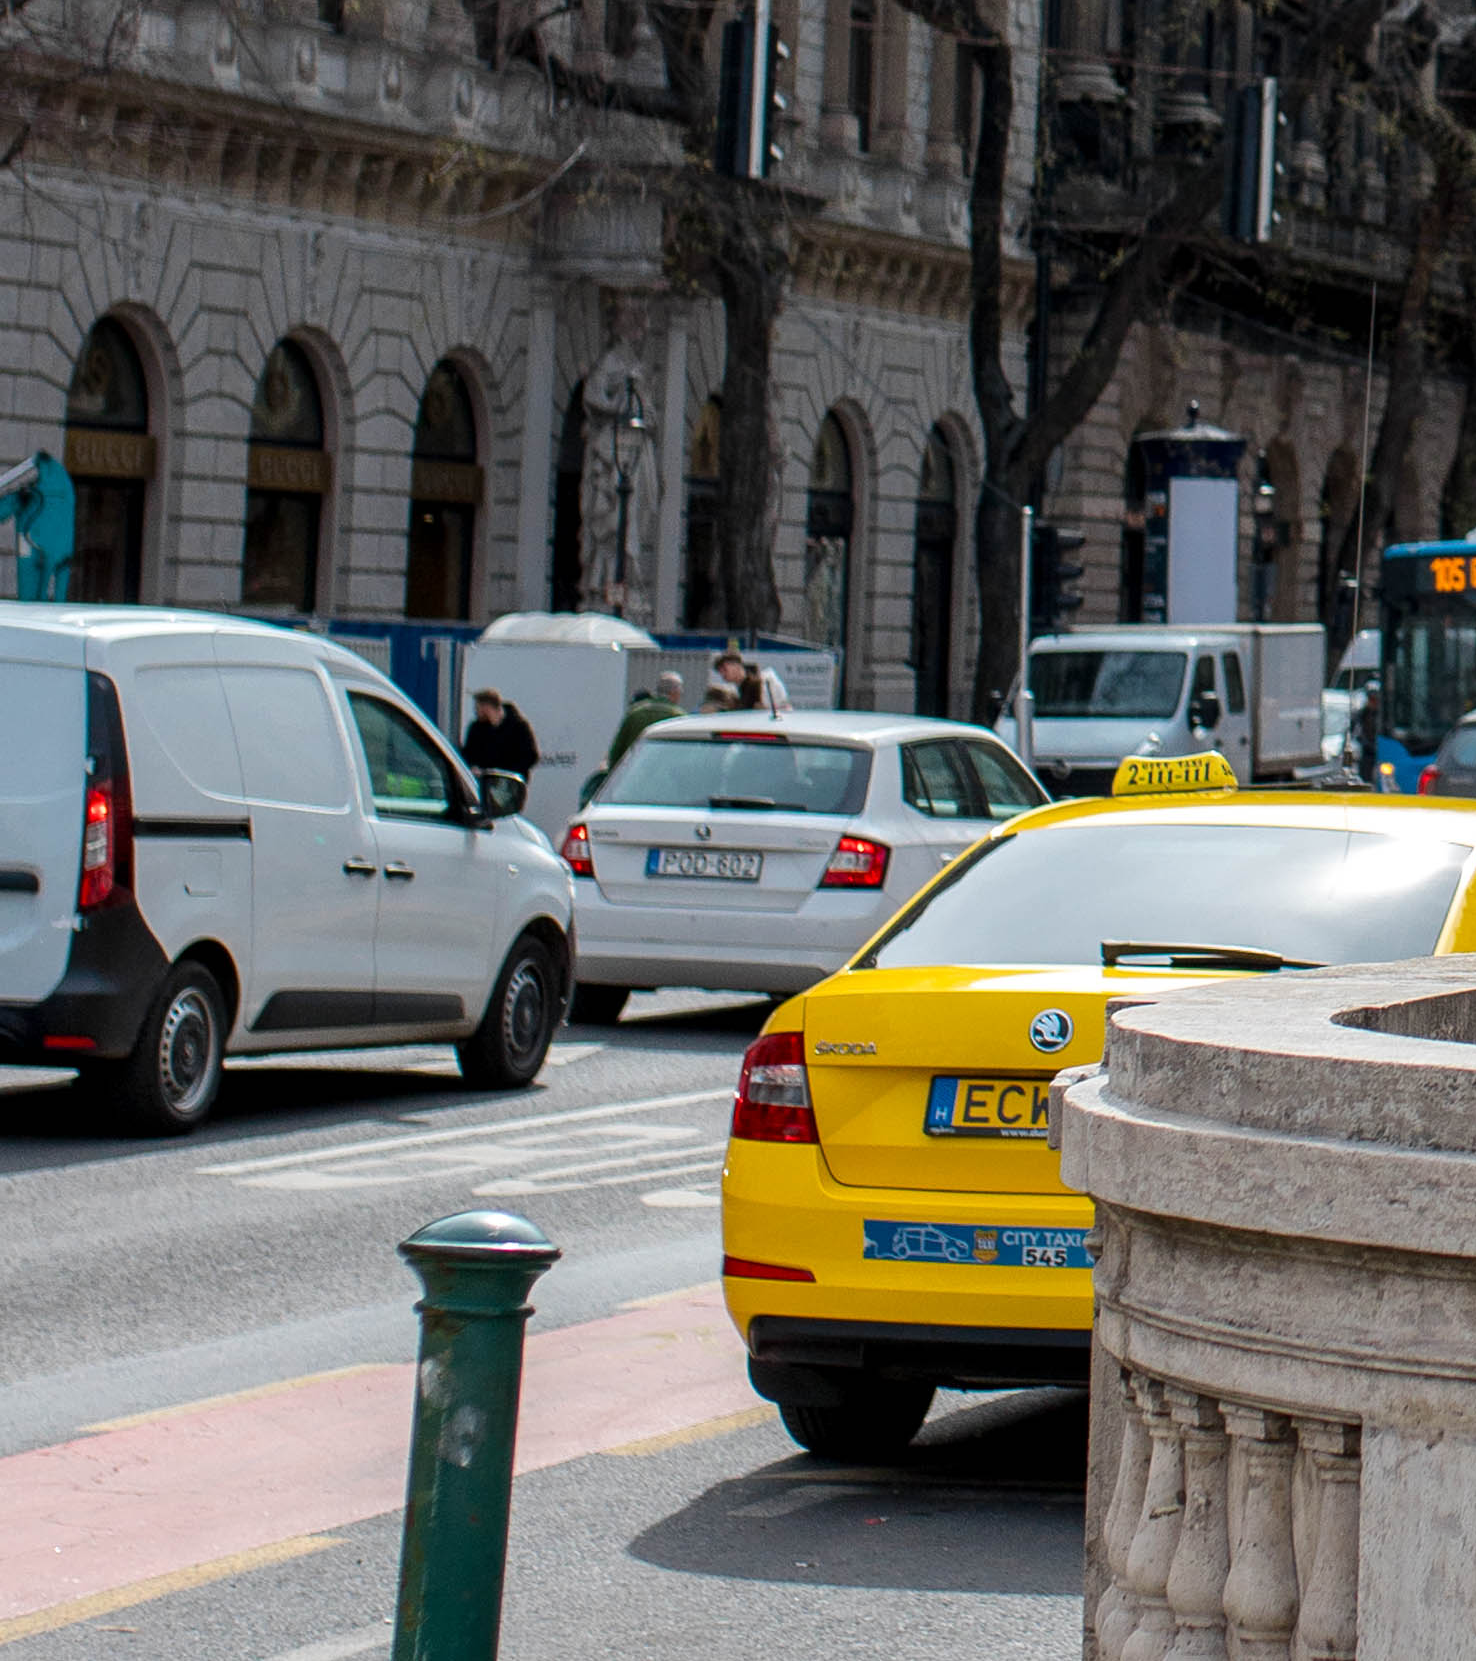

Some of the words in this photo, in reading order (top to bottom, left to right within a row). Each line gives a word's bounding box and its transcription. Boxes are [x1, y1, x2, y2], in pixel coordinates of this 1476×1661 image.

[1430, 556, 1467, 592] 105
[814, 1039, 877, 1056] ŠKODA
[935, 1106, 948, 1121] H
[1002, 1230, 1041, 1246] CITY
[1043, 1232, 1082, 1248] TAXI
[1025, 1247, 1068, 1266] 545
